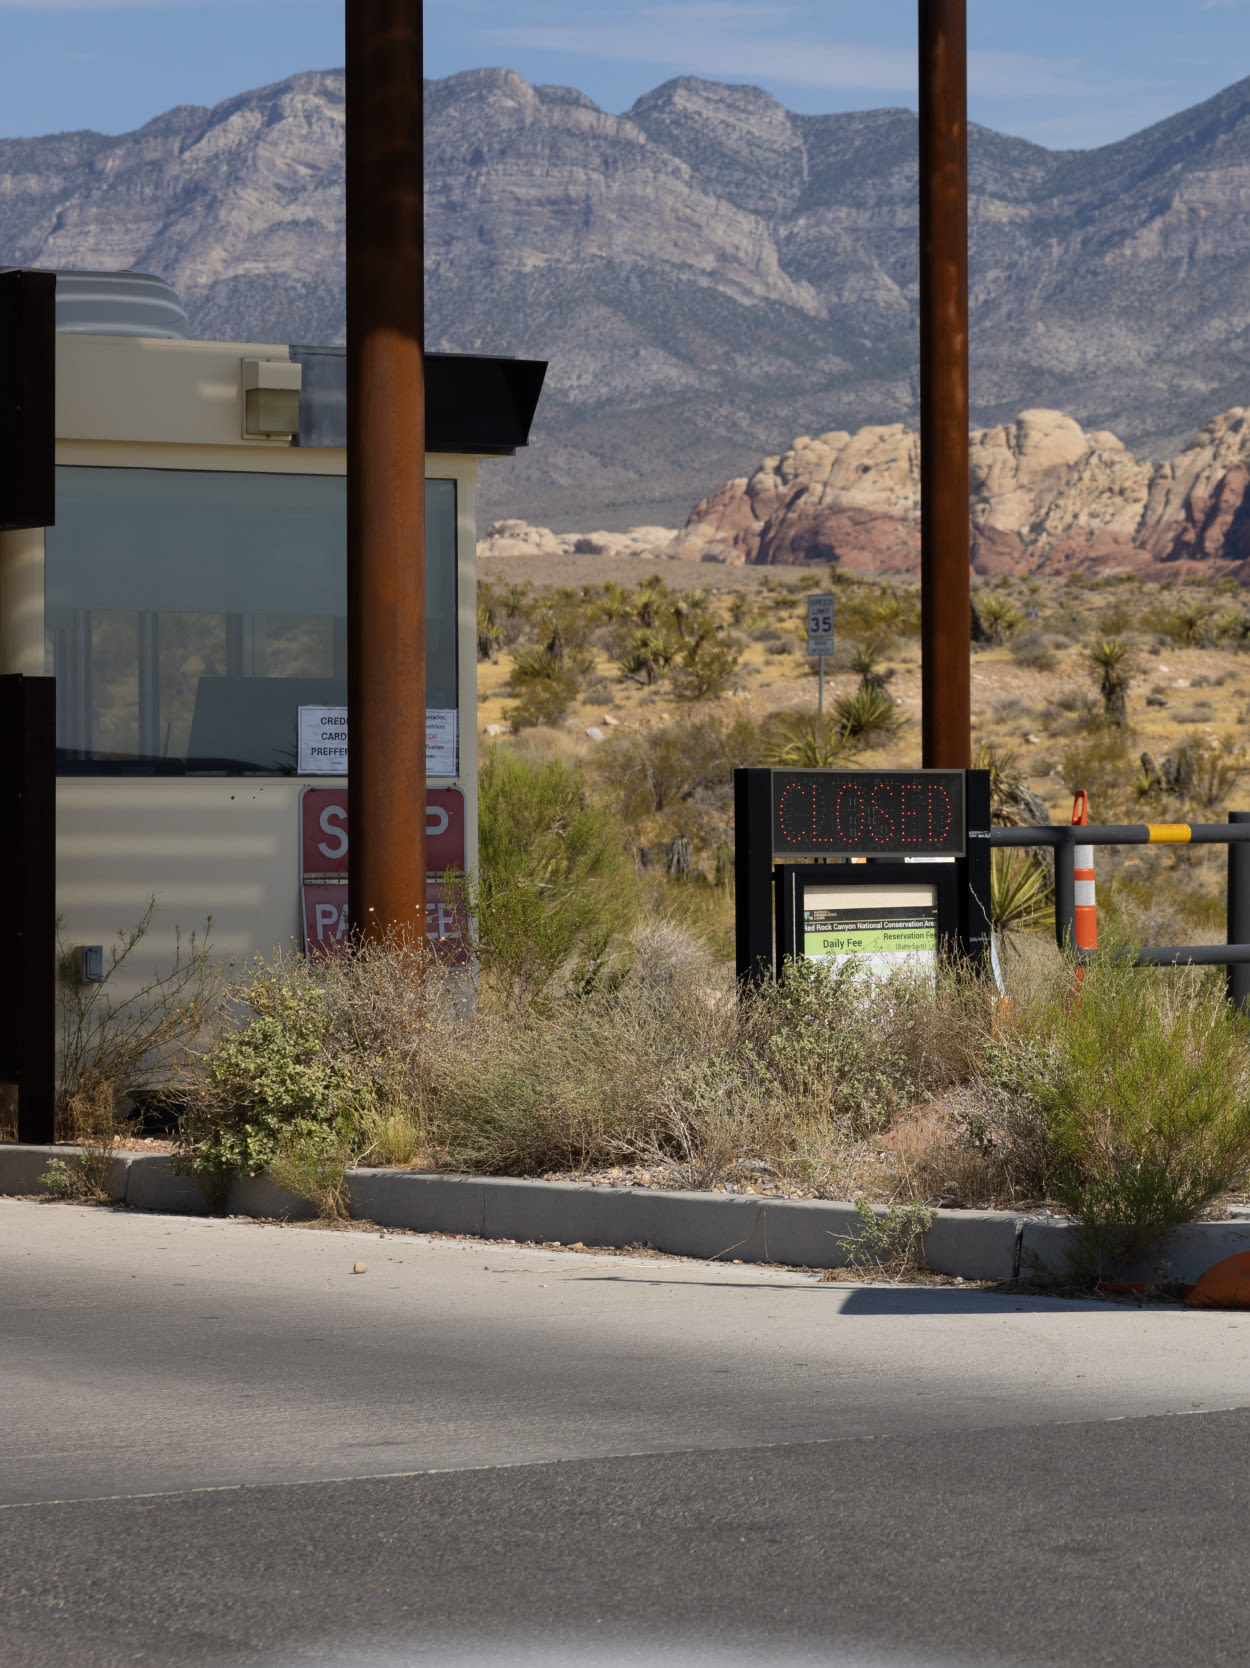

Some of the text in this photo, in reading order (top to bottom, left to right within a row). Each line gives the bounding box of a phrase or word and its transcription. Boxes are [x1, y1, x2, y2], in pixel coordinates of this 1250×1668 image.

[811, 616, 832, 633] 35
[320, 716, 347, 726] CRED
[778, 783, 952, 844] CLOSED
[816, 923, 833, 931] Rock
[833, 923, 856, 932] Canyon
[857, 921, 883, 930] National
[883, 920, 923, 928] Conservation
[883, 932, 924, 940] Reservation
[823, 938, 863, 950] Daily Fee
